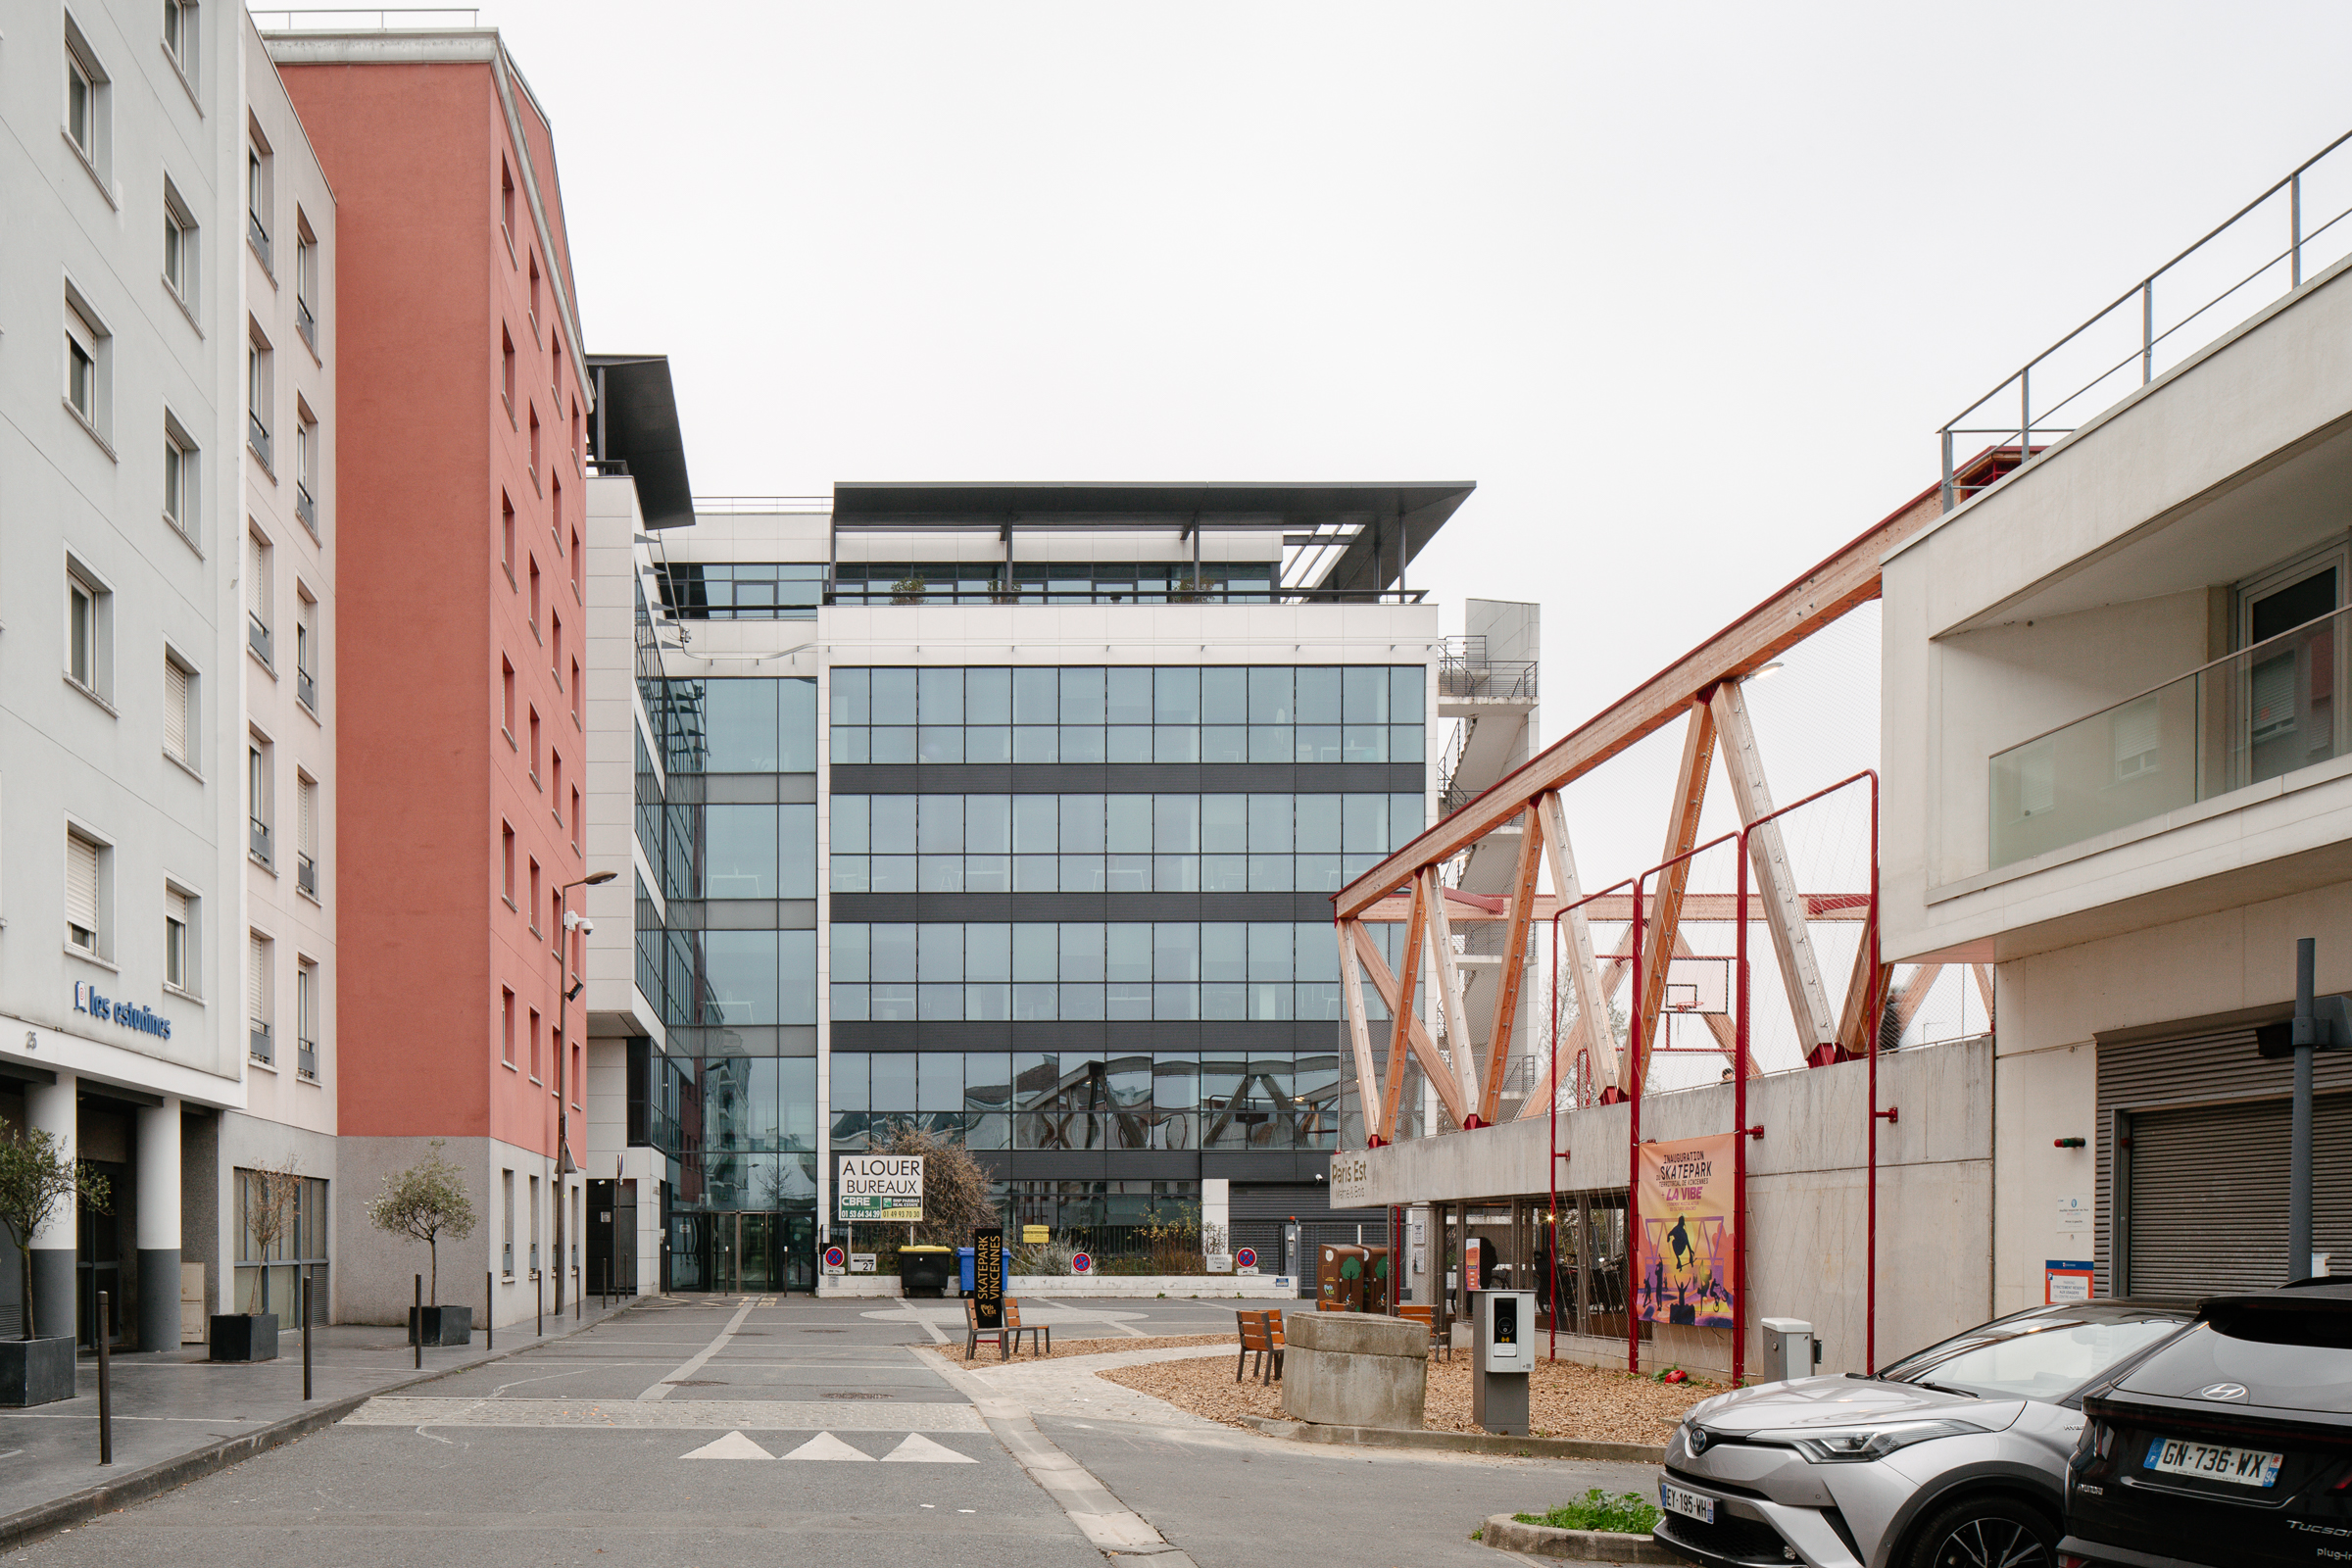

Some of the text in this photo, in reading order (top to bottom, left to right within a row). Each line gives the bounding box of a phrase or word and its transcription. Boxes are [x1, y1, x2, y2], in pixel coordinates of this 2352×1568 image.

[89, 986, 172, 1040] les estudines
[1663, 1151, 1705, 1164] INAUGURATION
[843, 1160, 920, 1176] A LOUER
[1332, 1160, 1367, 1184] Paris Est
[1660, 1161, 1712, 1180] SKATEPARK
[847, 1180, 917, 1194] BUREAUX
[1666, 1188, 1679, 1201] LA
[1681, 1187, 1703, 1200] VIBE
[842, 1197, 871, 1206] CBRE
[862, 1262, 874, 1271] 27
[978, 1236, 989, 1299] SKATEPARK
[990, 1235, 1001, 1299] VINCENNES
[2162, 1443, 2267, 1478] GN-736-WX
[2265, 1471, 2277, 1483] 94
[2078, 1483, 2103, 1495] HYUNDAI
[1667, 1488, 1707, 1519] EY-195-WH
